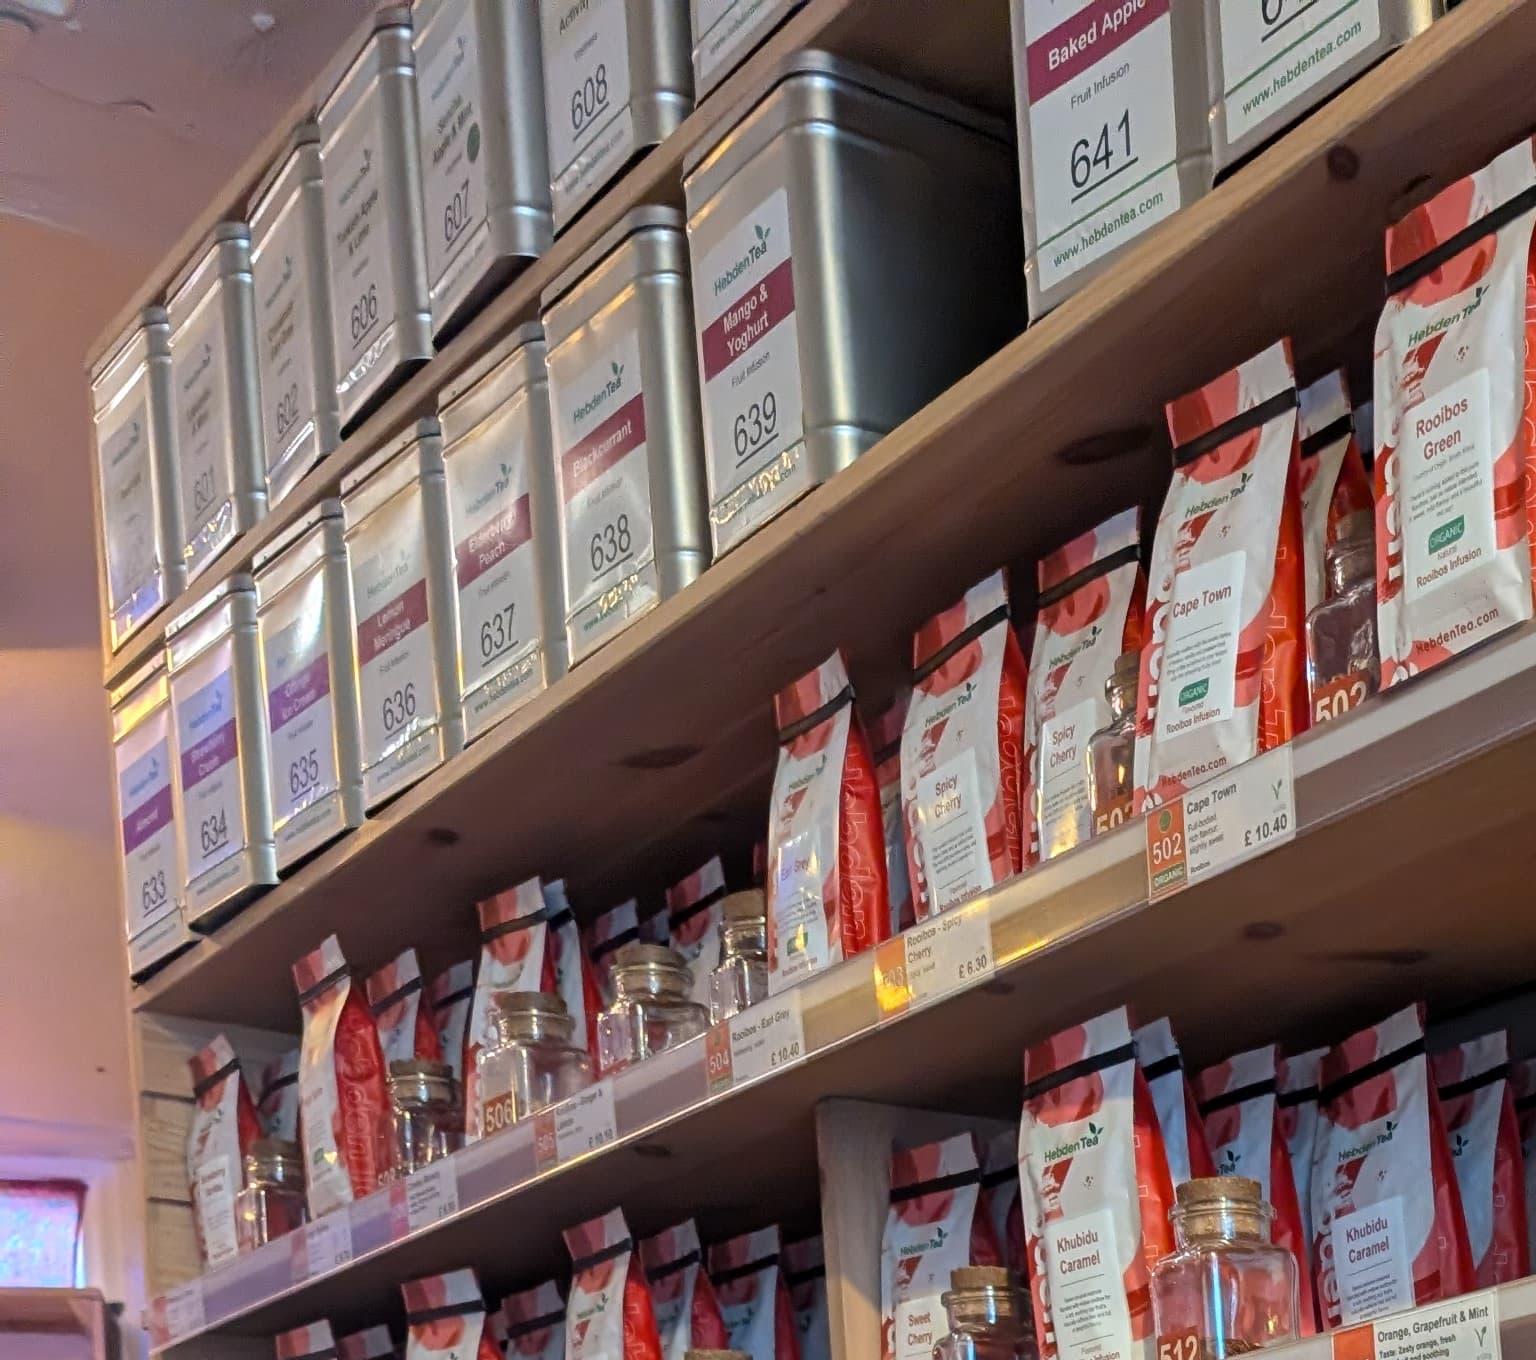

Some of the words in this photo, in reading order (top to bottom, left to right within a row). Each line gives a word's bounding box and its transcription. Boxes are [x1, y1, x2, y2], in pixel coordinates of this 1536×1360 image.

[1047, 31, 1097, 71] Baked
[1241, 20, 1362, 116] www.hebdentea.com
[570, 61, 609, 131] 608
[1070, 81, 1091, 109] Fruit
[1088, 61, 1131, 97] Infusion
[1069, 109, 1136, 189] 641
[1052, 189, 1164, 268] www.hebdentea.com
[722, 300, 759, 331] Mango
[758, 282, 770, 301] &
[725, 314, 770, 358] Yoghurt
[731, 391, 778, 458] 639
[1415, 396, 1469, 438] Rooibos
[1423, 427, 1462, 462] Green
[589, 512, 632, 574] 638
[479, 603, 518, 661] 637
[1187, 791, 1212, 814] Cape
[1214, 780, 1237, 802] Town
[1151, 832, 1183, 865] 502
[1244, 830, 1252, 847] £
[1254, 813, 1288, 842] 10.40
[1056, 1230, 1099, 1255] Khubidu
[1059, 1251, 1101, 1275] Caramel
[1378, 1319, 1411, 1343] Orange,
[1411, 1311, 1455, 1337] Grapefruit
[1458, 1308, 1467, 1322] &
[1470, 1305, 1489, 1321] Mint
